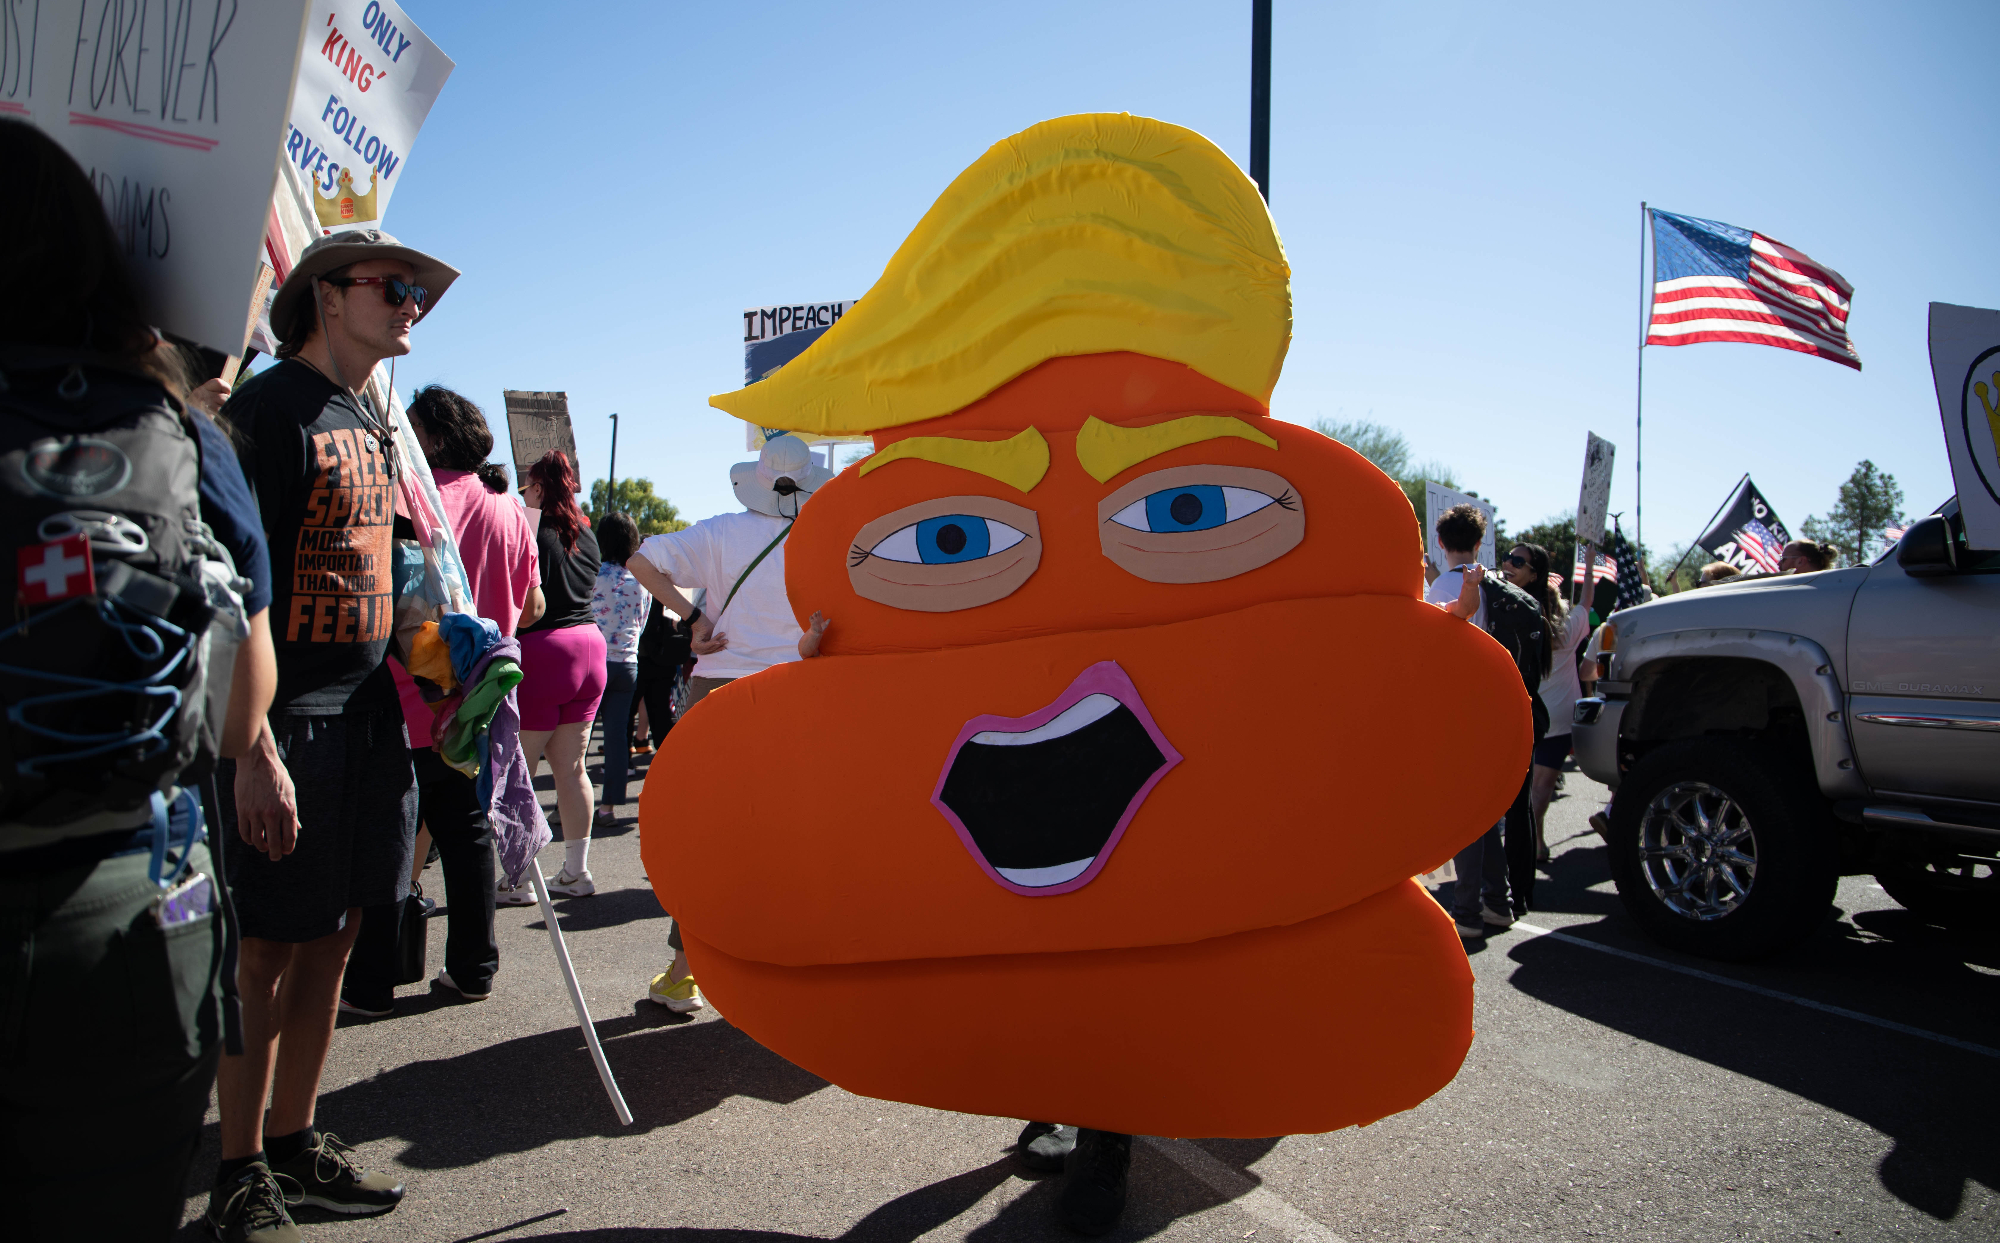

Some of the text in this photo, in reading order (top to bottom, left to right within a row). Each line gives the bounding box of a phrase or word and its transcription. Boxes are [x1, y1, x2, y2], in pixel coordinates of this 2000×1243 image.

[362, 0, 411, 63] ONLY
[69, 0, 238, 124] FOREVER
[321, 13, 387, 93] 'KING'
[286, 122, 340, 191] RVES
[321, 94, 400, 180] FOLLOW
[744, 303, 843, 342] IMPEACH
[312, 428, 389, 488] FREE
[303, 486, 393, 527] SPEECH
[299, 529, 354, 552] MORE
[1768, 521, 1789, 546] KIN
[297, 554, 374, 572] IMPORTANT
[1713, 541, 1766, 575] AME
[297, 574, 376, 592] THAN YOUR
[1898, 683, 1983, 694] DURAMAX
